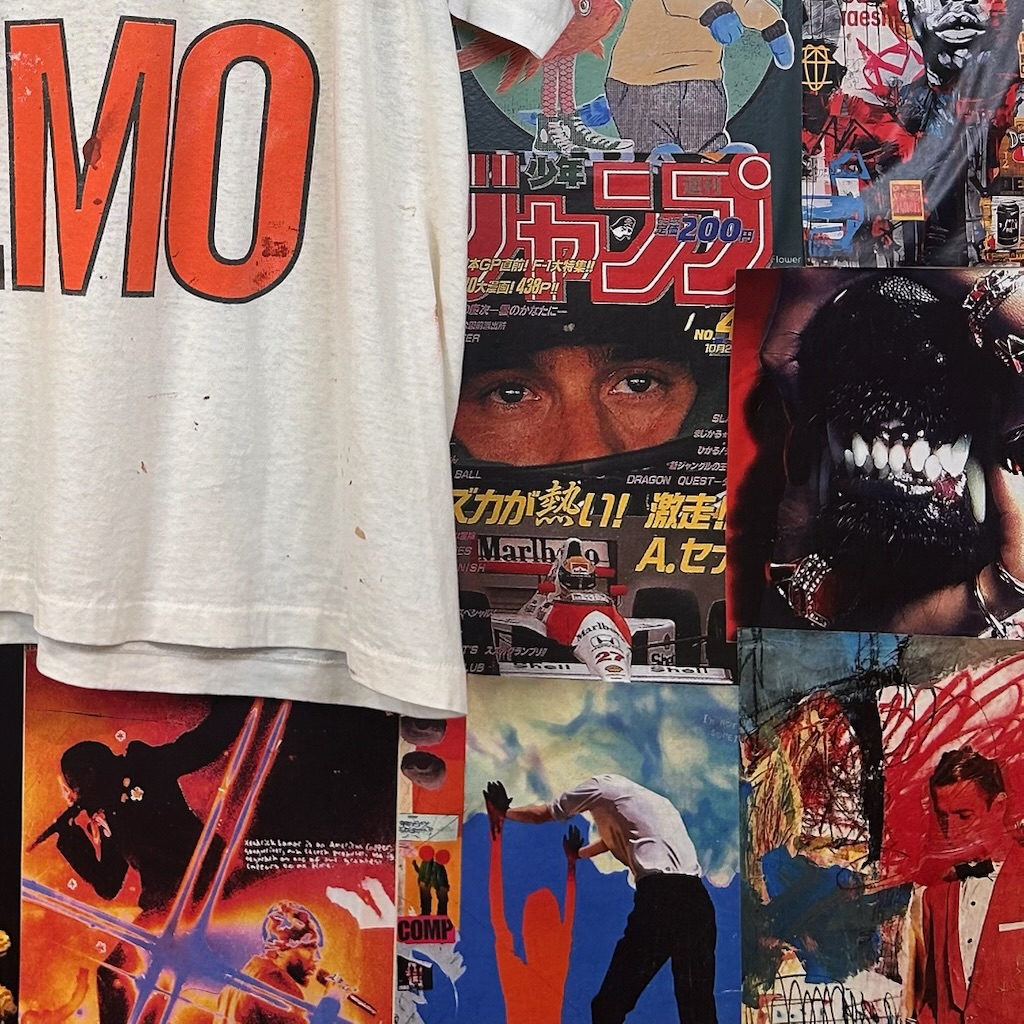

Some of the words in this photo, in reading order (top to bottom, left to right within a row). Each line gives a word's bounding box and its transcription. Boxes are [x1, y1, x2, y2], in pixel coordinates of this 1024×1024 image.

[525, 156, 587, 190] 少年
[467, 257, 528, 273] 本GP直前!
[464, 334, 480, 343] ER
[454, 470, 482, 479] BALL
[626, 474, 672, 485] DRAGON
[644, 491, 728, 531] 激走!
[478, 535, 601, 566] Marlbo
[595, 649, 625, 664] 27
[512, 662, 571, 671] Shell
[650, 665, 708, 675] Shell
[397, 919, 454, 941] COMP
